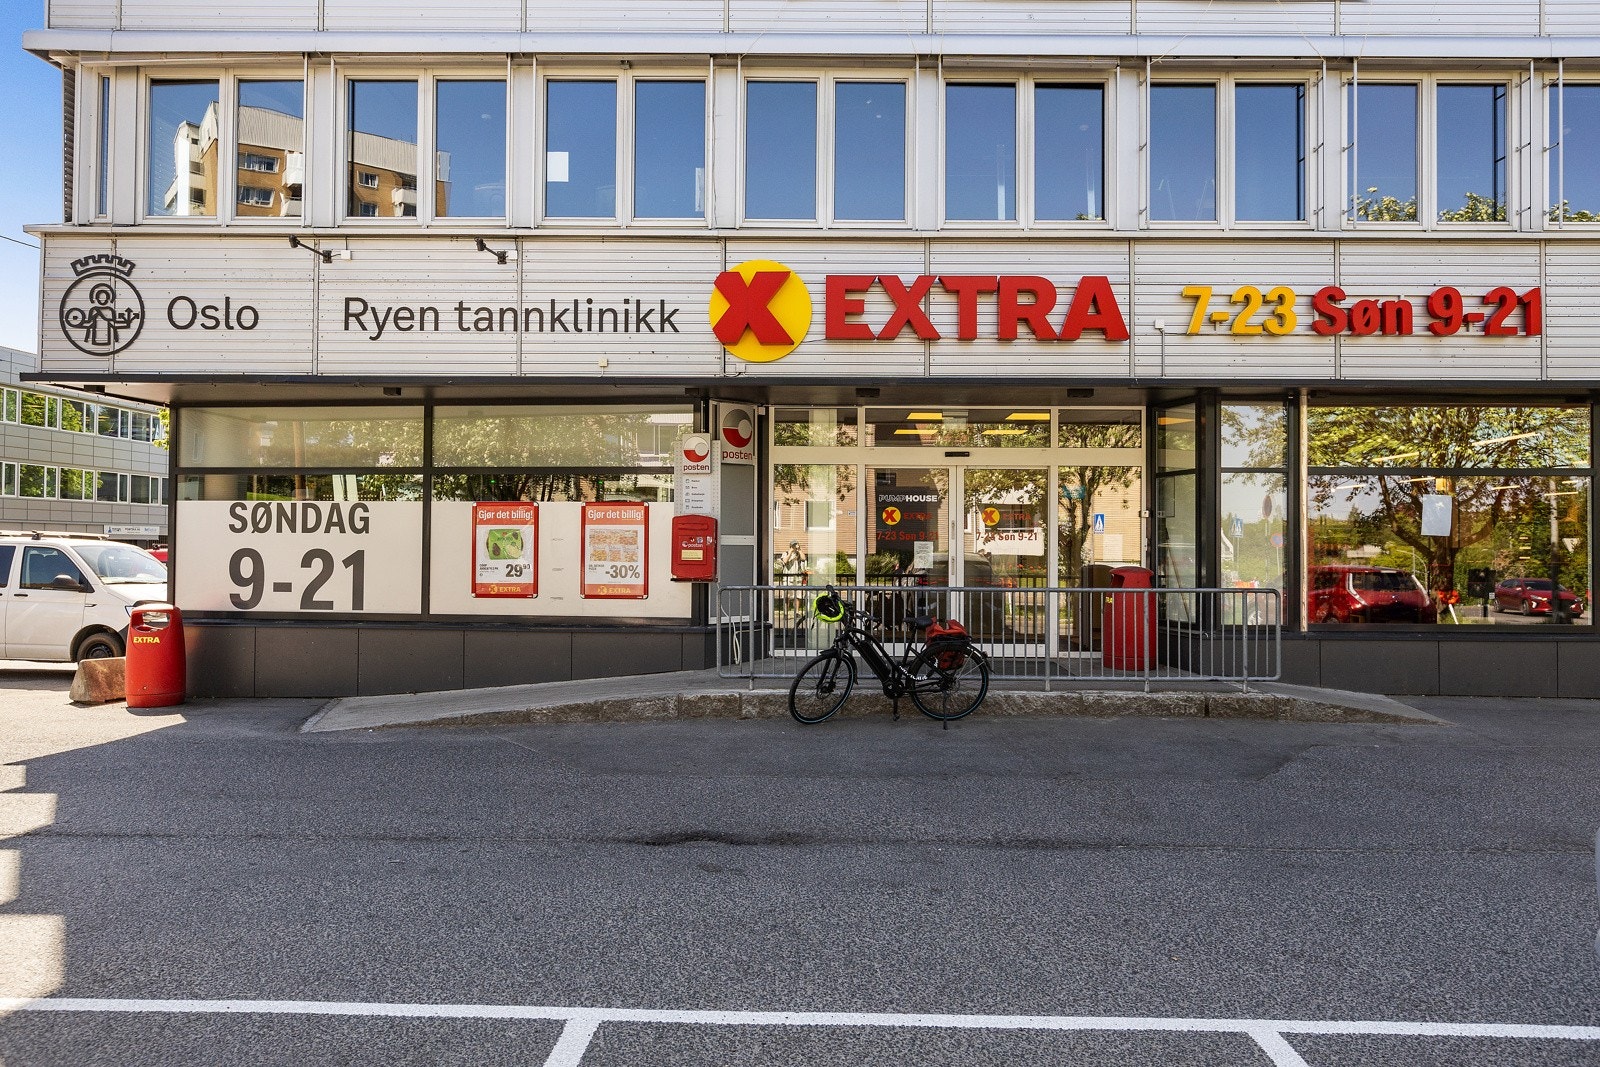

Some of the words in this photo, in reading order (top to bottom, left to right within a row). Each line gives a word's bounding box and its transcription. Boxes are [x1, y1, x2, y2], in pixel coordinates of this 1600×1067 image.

[168, 296, 259, 330] Oslo
[825, 275, 1130, 342] EXTRA
[1182, 285, 1298, 336] 7-23
[1311, 285, 1414, 336] Søn
[1427, 286, 1542, 336] 9-21
[344, 297, 440, 341] Ryen
[456, 298, 680, 334] tannklinikk
[722, 450, 753, 461] posten
[683, 463, 710, 471] posten
[878, 494, 938, 502] PUMPHOUSE
[228, 501, 371, 535] SØNDAG
[478, 510, 495, 520] Gjør
[496, 510, 510, 519] det
[511, 510, 533, 520] billig!
[606, 510, 620, 519] det
[621, 510, 644, 520] billig!
[877, 532, 897, 541] 7-23
[998, 532, 1016, 541] Søn
[1017, 532, 1038, 541] 9-21
[605, 564, 640, 579] -30%
[229, 547, 364, 612] 9-21
[133, 636, 160, 644] EXTRA
